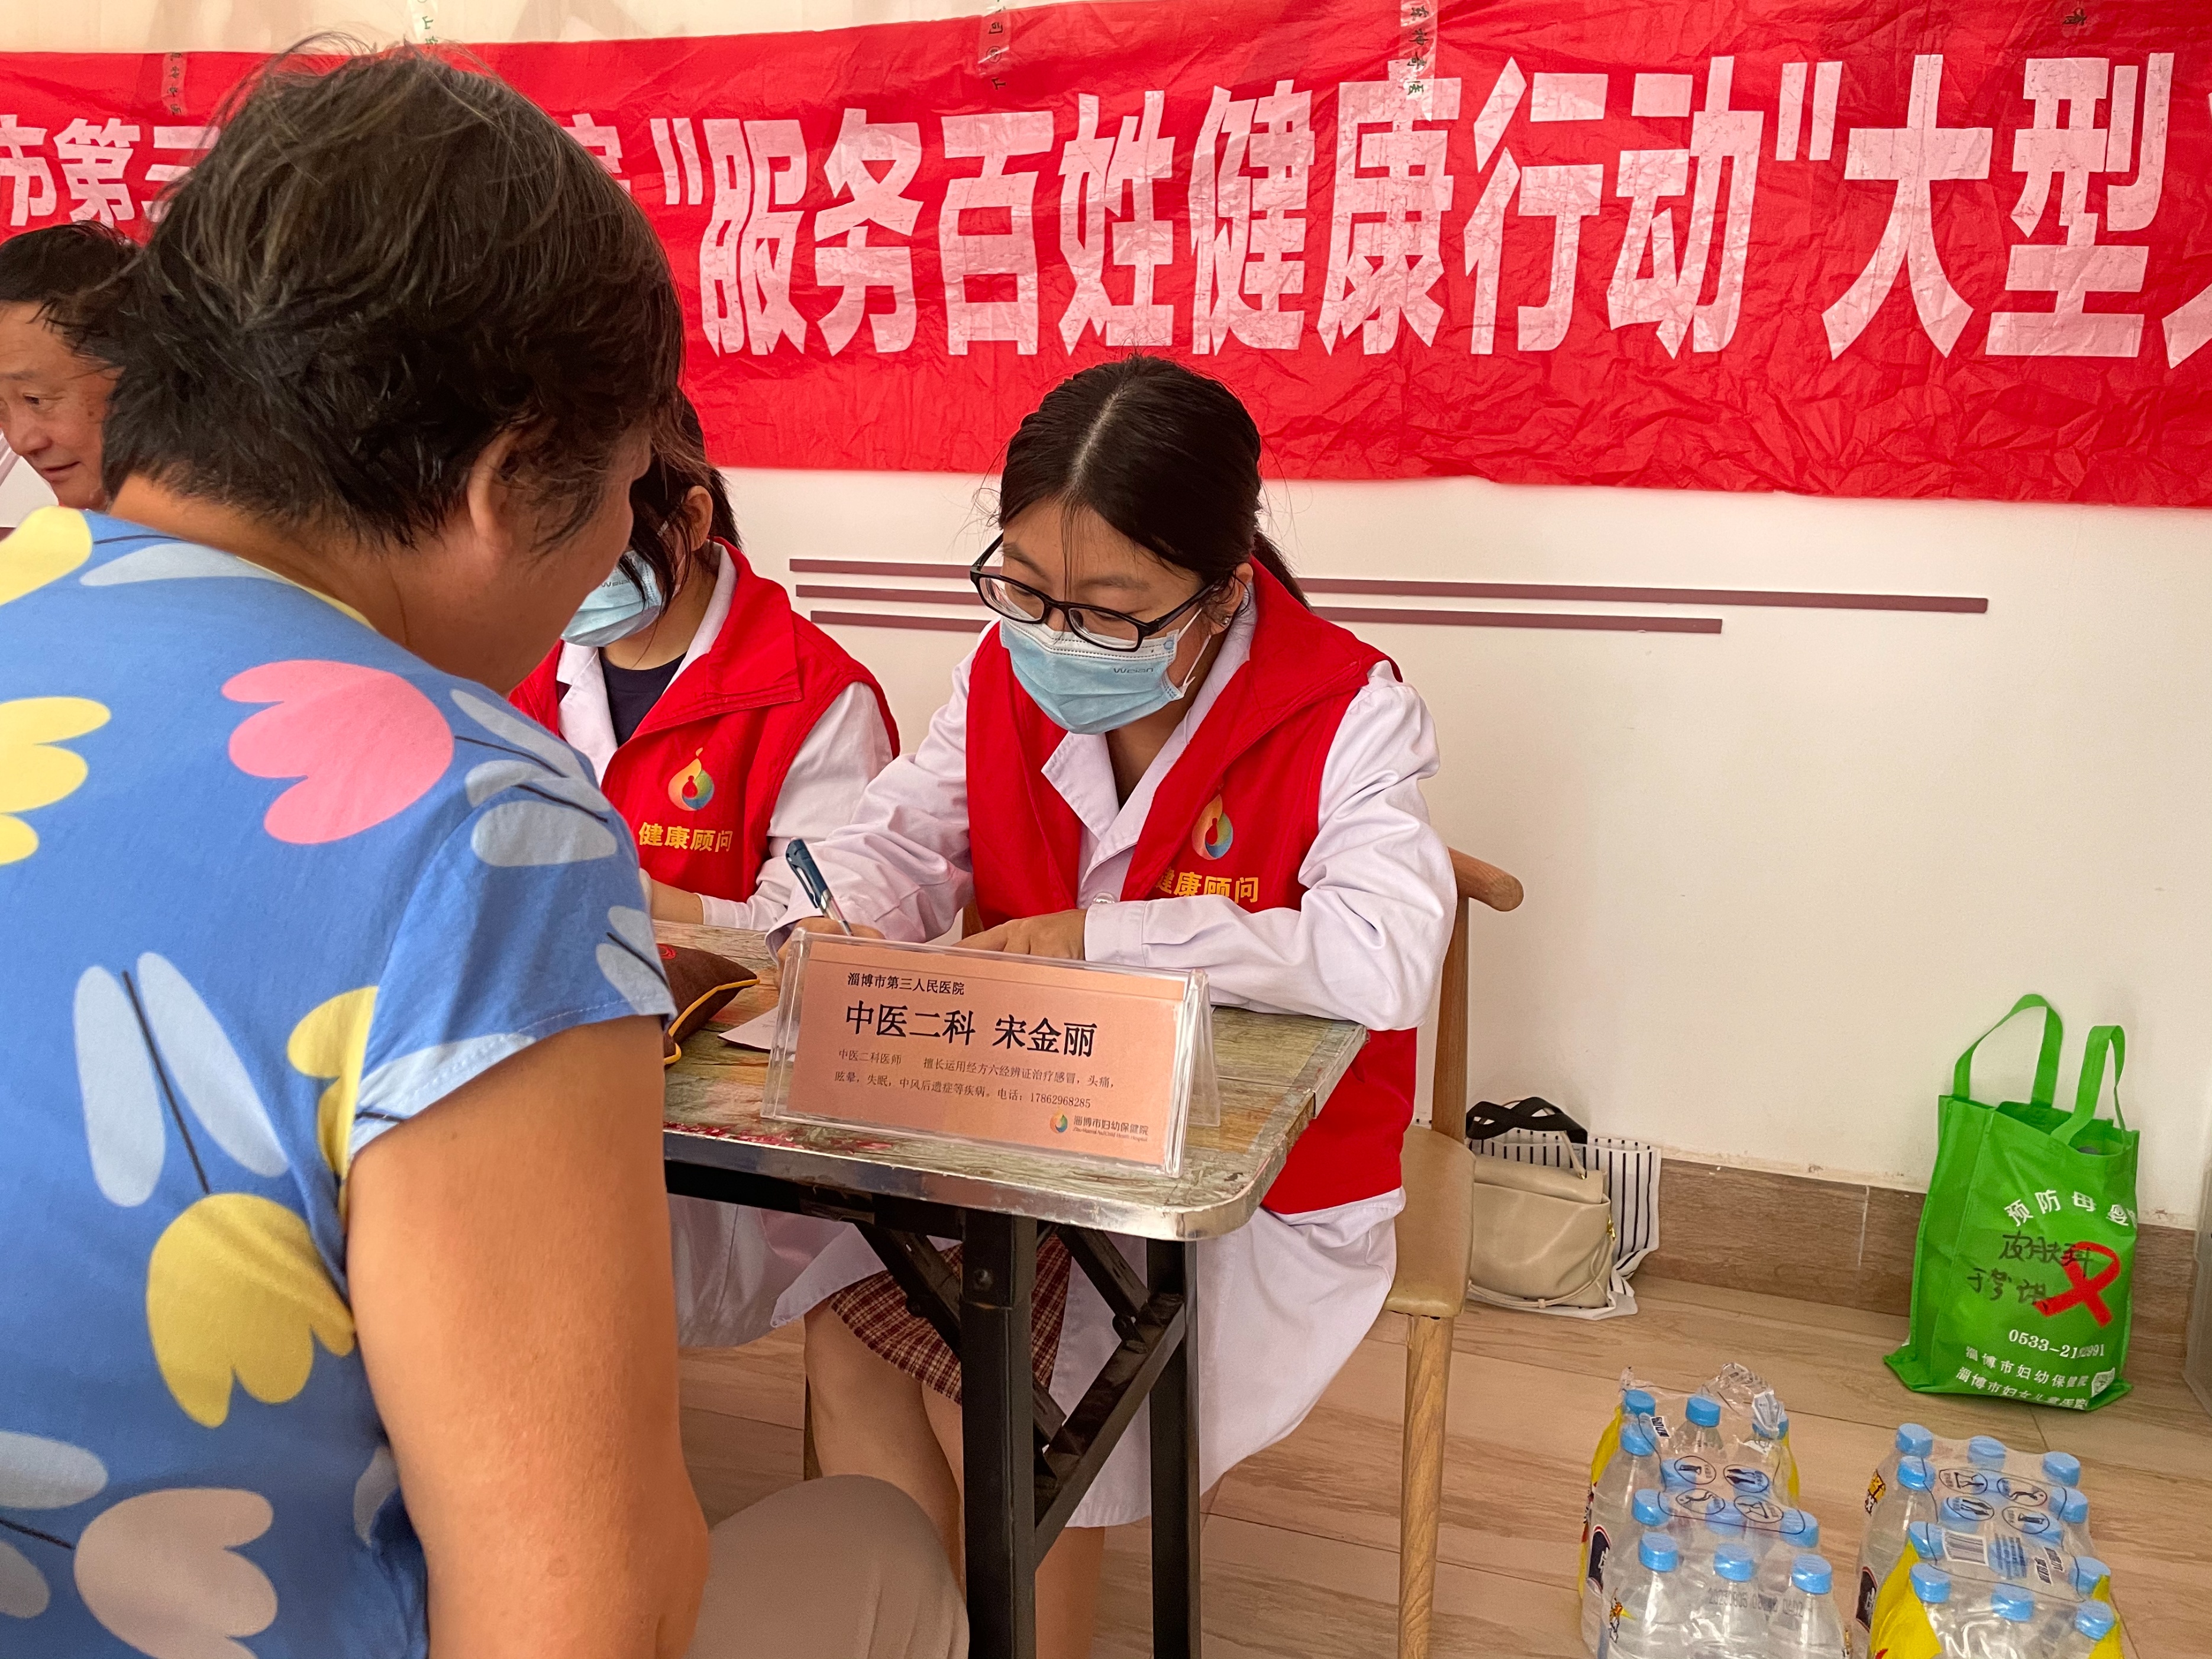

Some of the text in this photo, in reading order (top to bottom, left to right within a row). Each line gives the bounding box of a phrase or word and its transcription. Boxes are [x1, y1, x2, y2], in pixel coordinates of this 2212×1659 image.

[638, 821, 733, 853] 健康顾问
[847, 972, 964, 995] 淄博市第三人民医院
[845, 1000, 1097, 1057] 中医二科 宋金丽
[838, 1048, 902, 1066] 中医二科医师
[1073, 1115, 1149, 1136] 淄博市妇幼保健院
